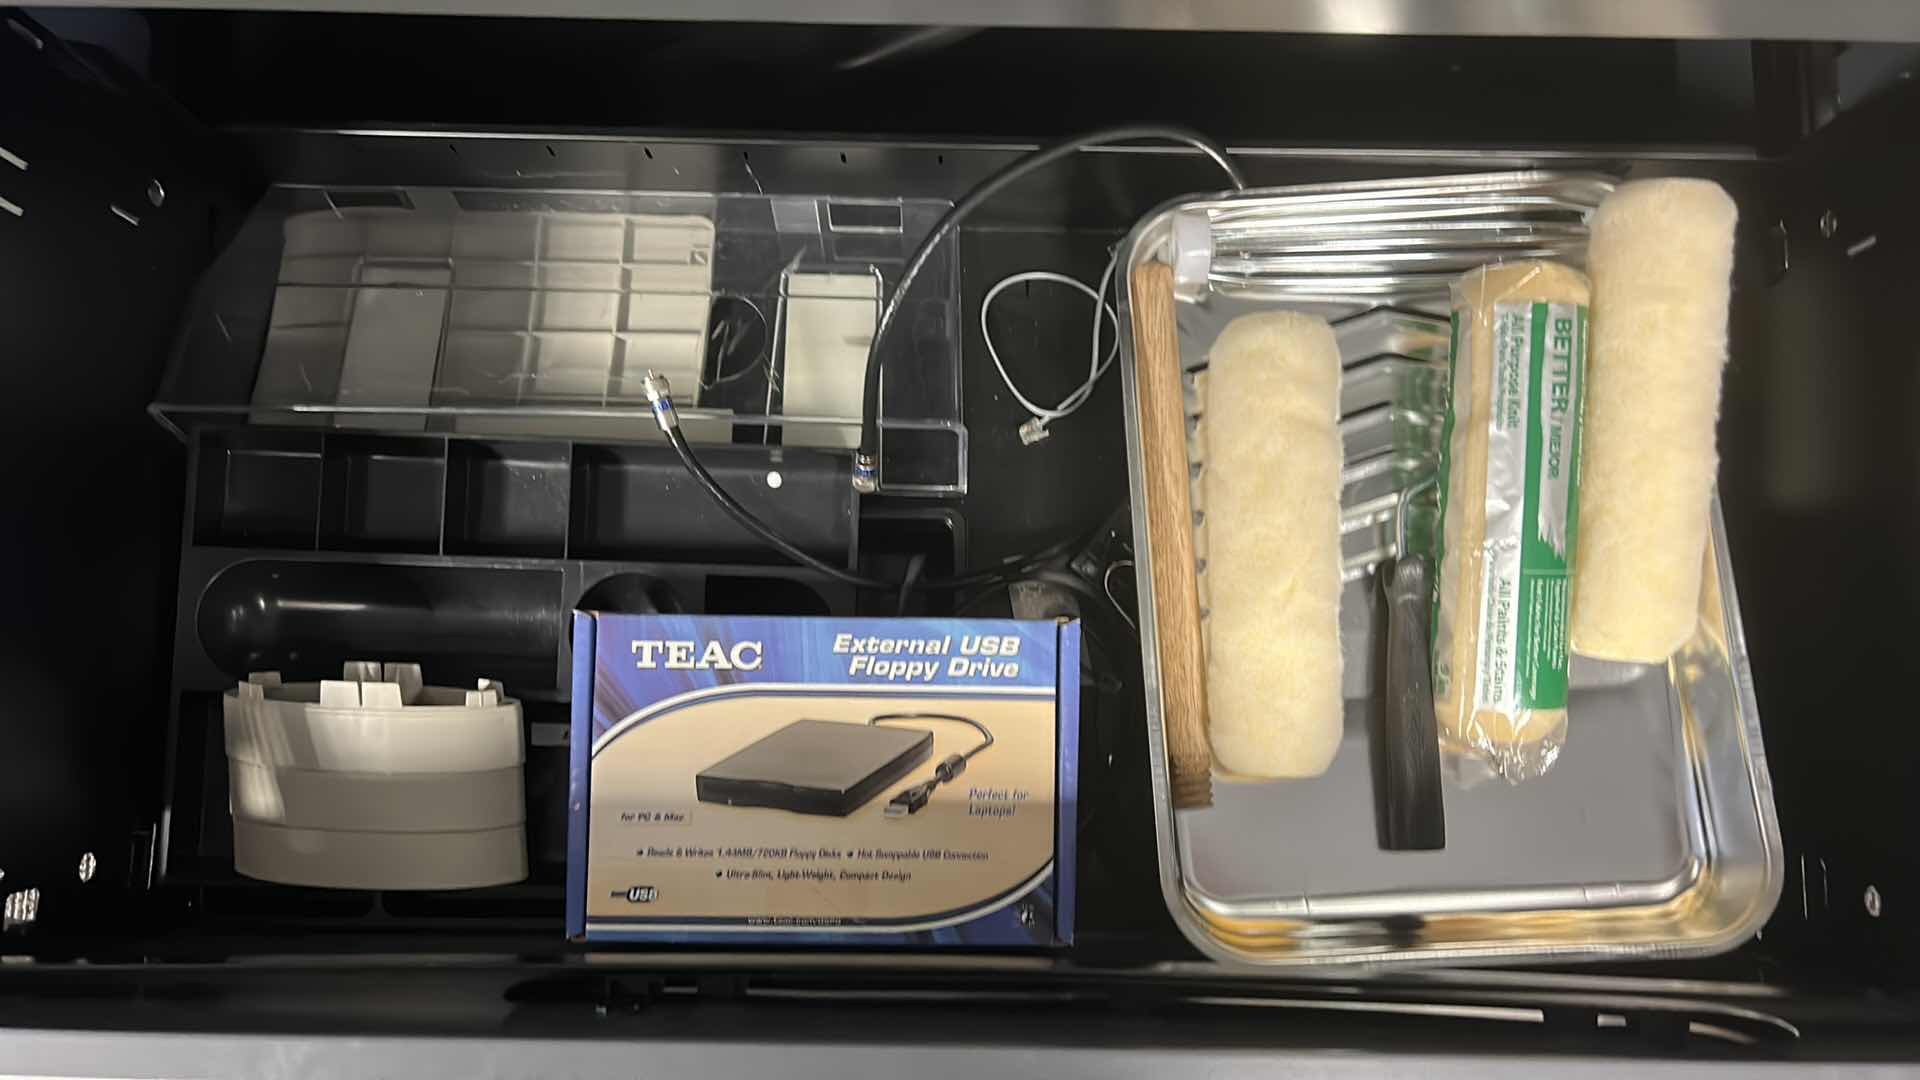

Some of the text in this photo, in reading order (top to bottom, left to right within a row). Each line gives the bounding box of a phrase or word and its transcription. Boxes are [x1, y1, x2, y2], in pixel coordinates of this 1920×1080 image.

[1504, 312, 1525, 433] All Purpose Knit
[1552, 318, 1573, 414] BETTER
[1548, 424, 1562, 480] MEJOR
[631, 639, 763, 670] TEAC
[832, 633, 1021, 656] External USB
[1493, 576, 1512, 705] All Paints & Stains
[848, 655, 1020, 682] Floppy Drive
[968, 786, 1029, 801] Perfect for
